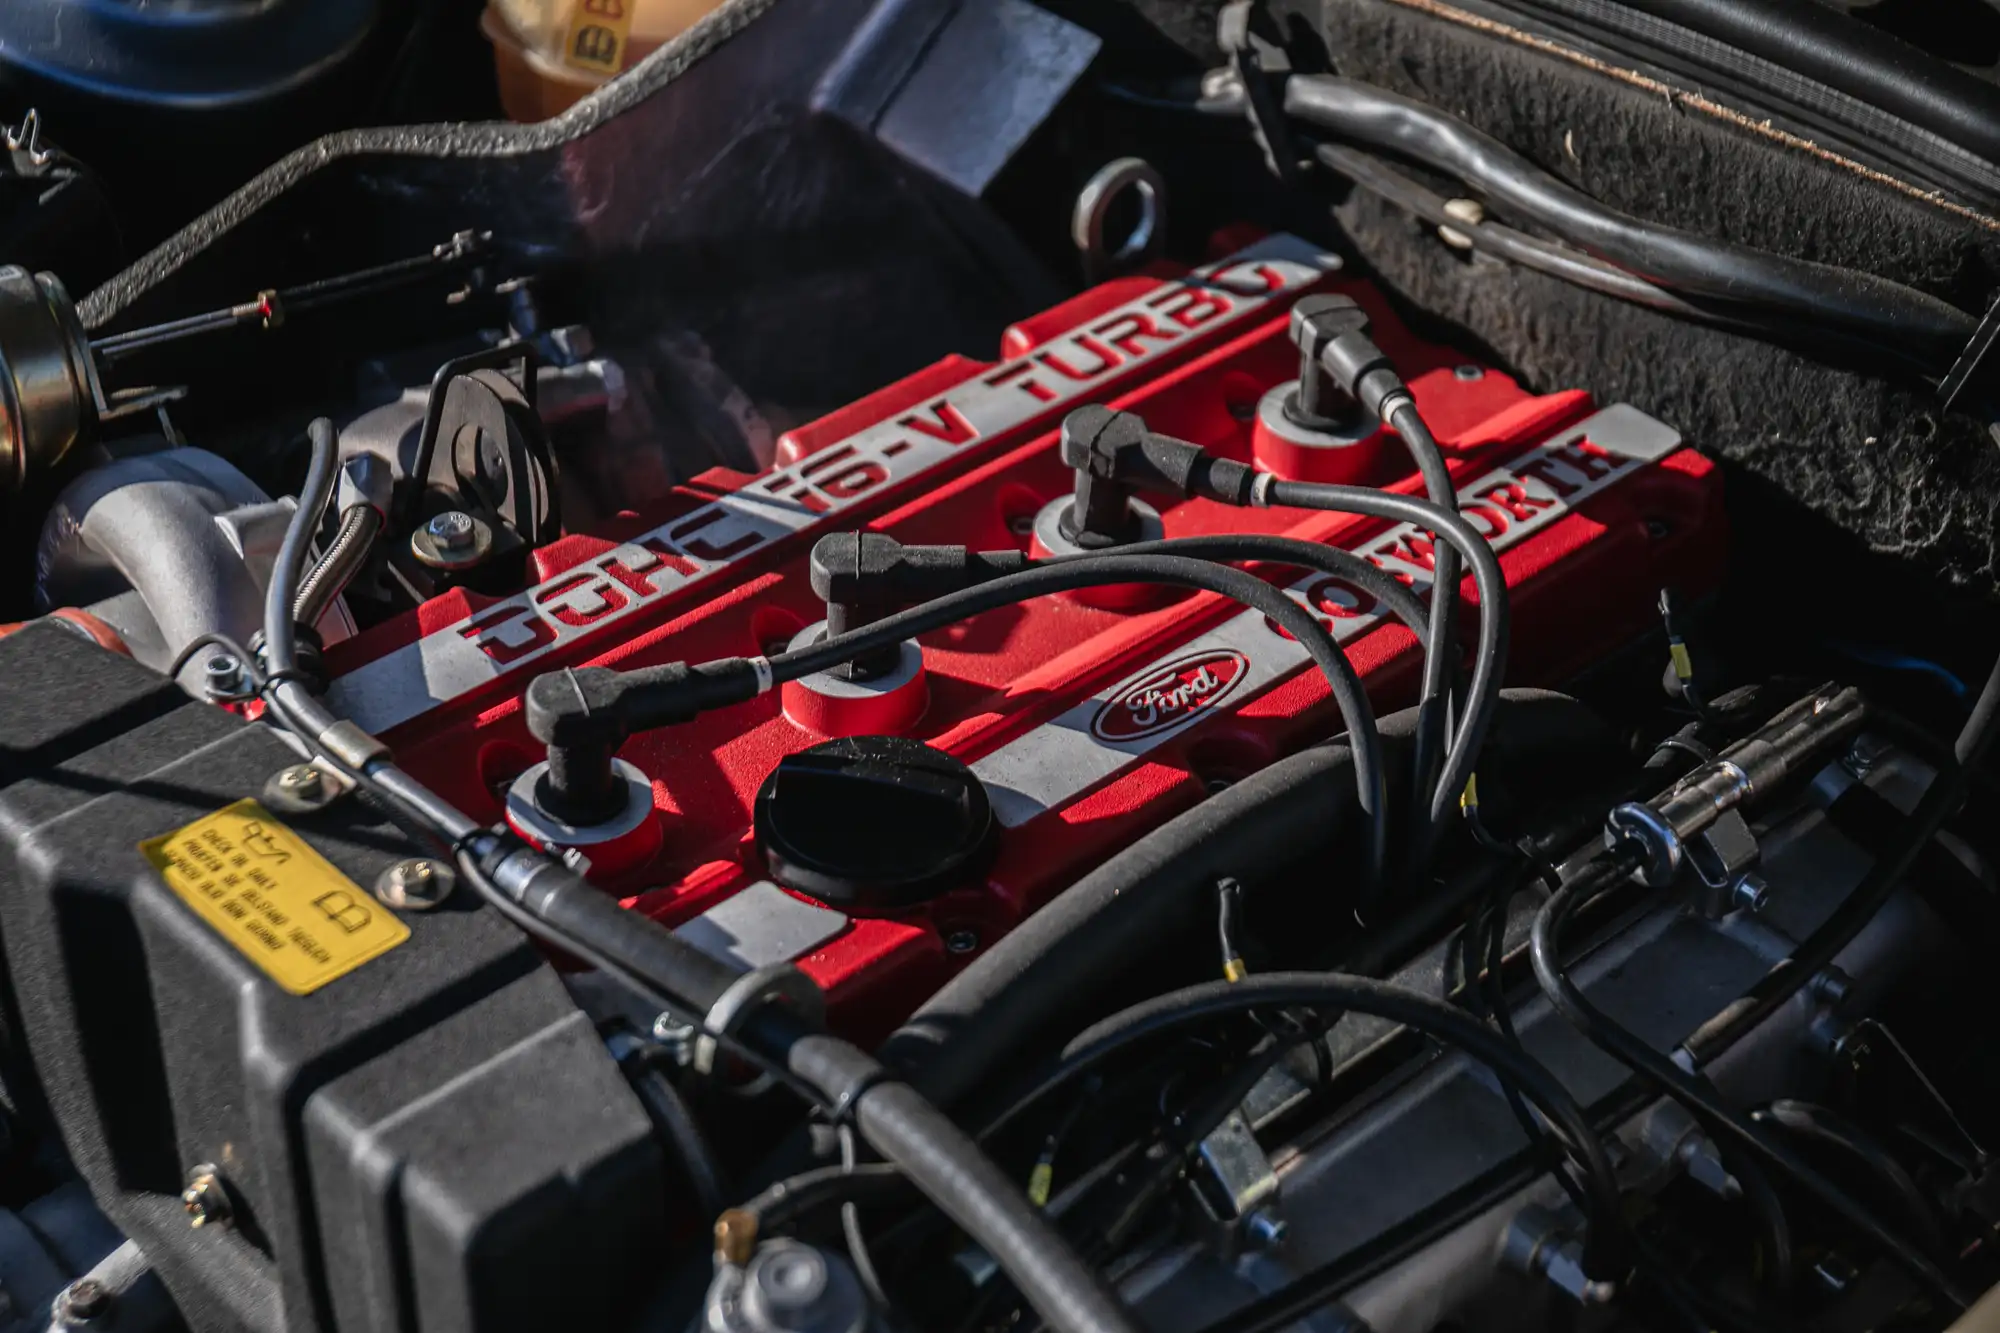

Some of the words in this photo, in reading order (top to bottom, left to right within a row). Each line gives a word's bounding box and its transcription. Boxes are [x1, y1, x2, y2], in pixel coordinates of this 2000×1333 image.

[456, 503, 764, 664] DOHC
[762, 399, 981, 515] 16-V
[982, 260, 1287, 402] TURBO
[1126, 665, 1218, 727] Ford
[201, 829, 236, 855] CHECK
